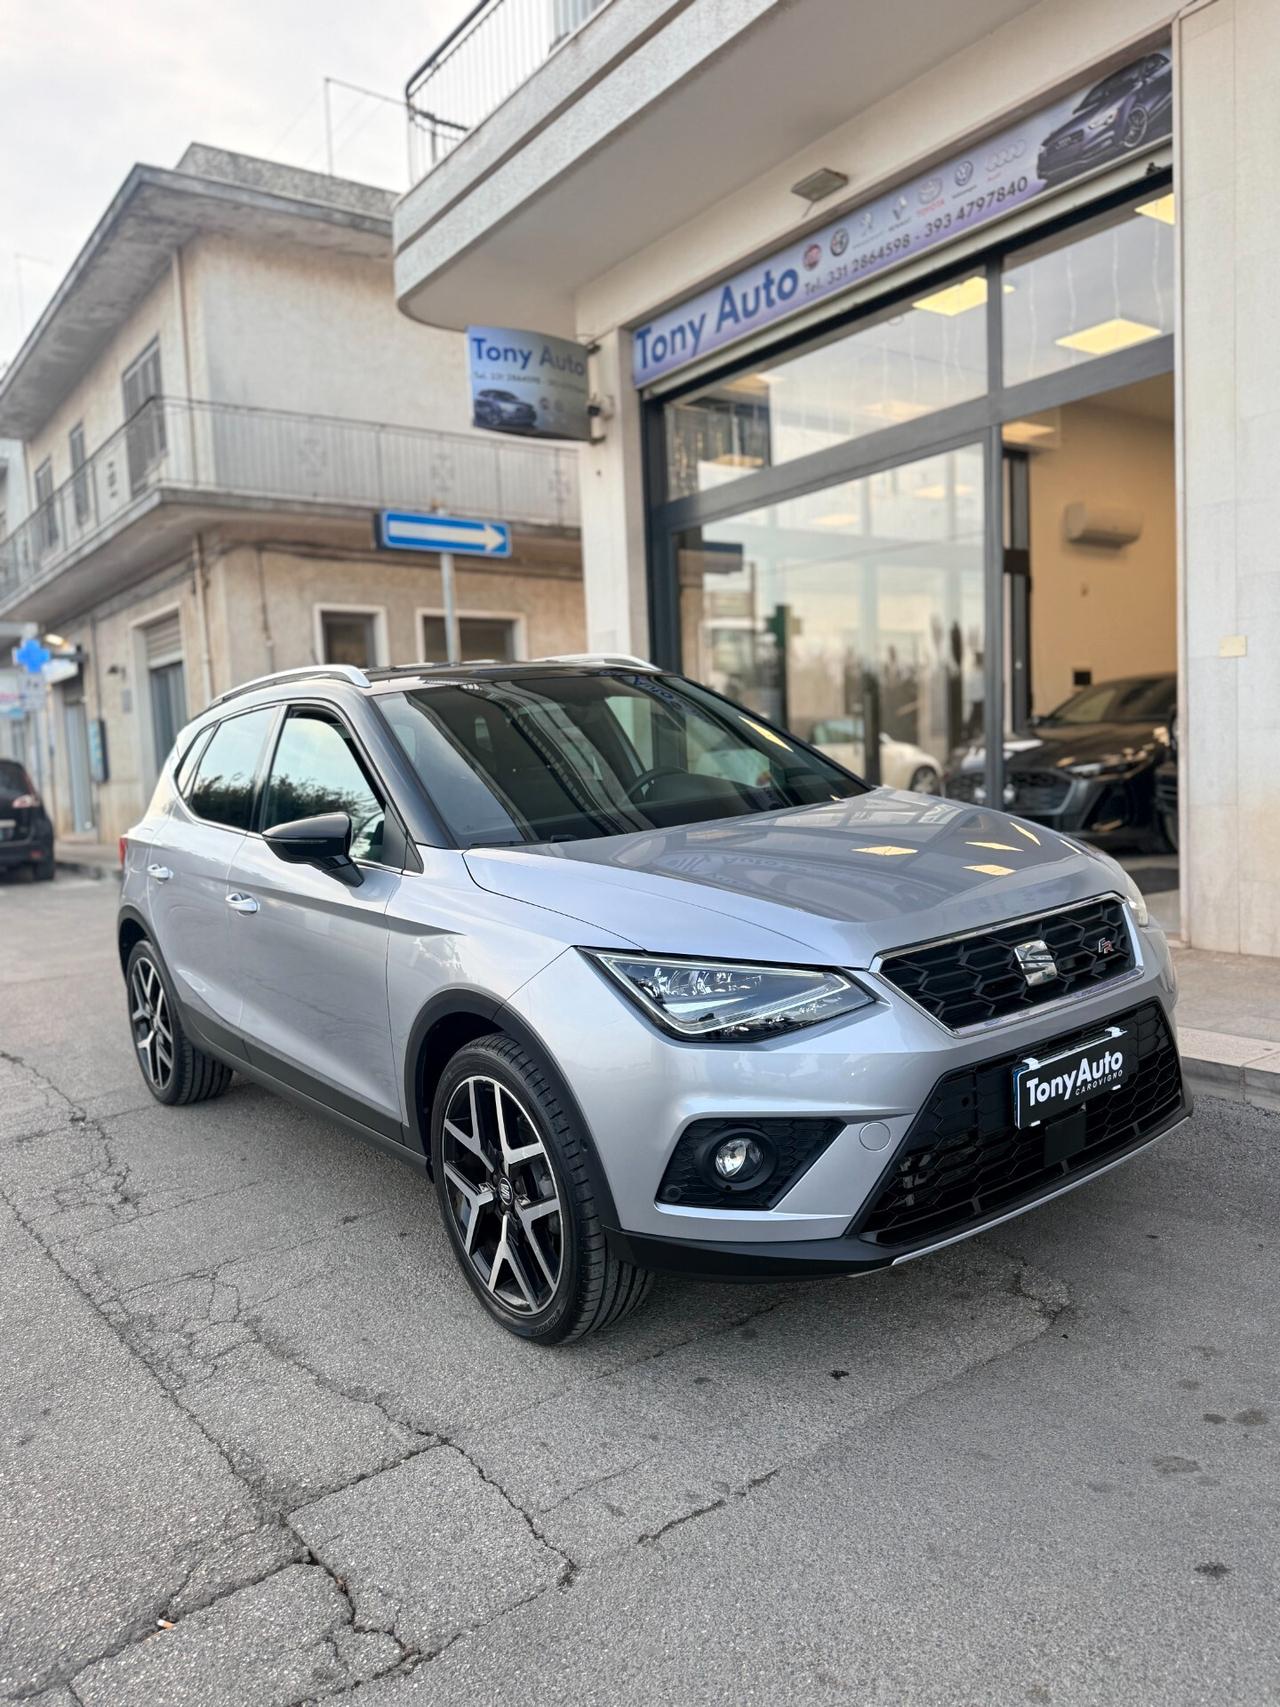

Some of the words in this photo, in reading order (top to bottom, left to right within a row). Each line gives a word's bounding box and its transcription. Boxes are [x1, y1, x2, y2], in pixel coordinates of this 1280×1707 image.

[827, 264, 849, 285] 331
[852, 233, 910, 272] 2864598
[924, 213, 952, 238] 393
[956, 176, 1028, 220] 4797840
[636, 313, 706, 369] Tony
[716, 268, 798, 333] Auto
[472, 338, 532, 370] Tony
[539, 345, 585, 376] Auto
[1098, 937, 1115, 954] FR
[1075, 1069, 1123, 1096] CAROVIGNO
